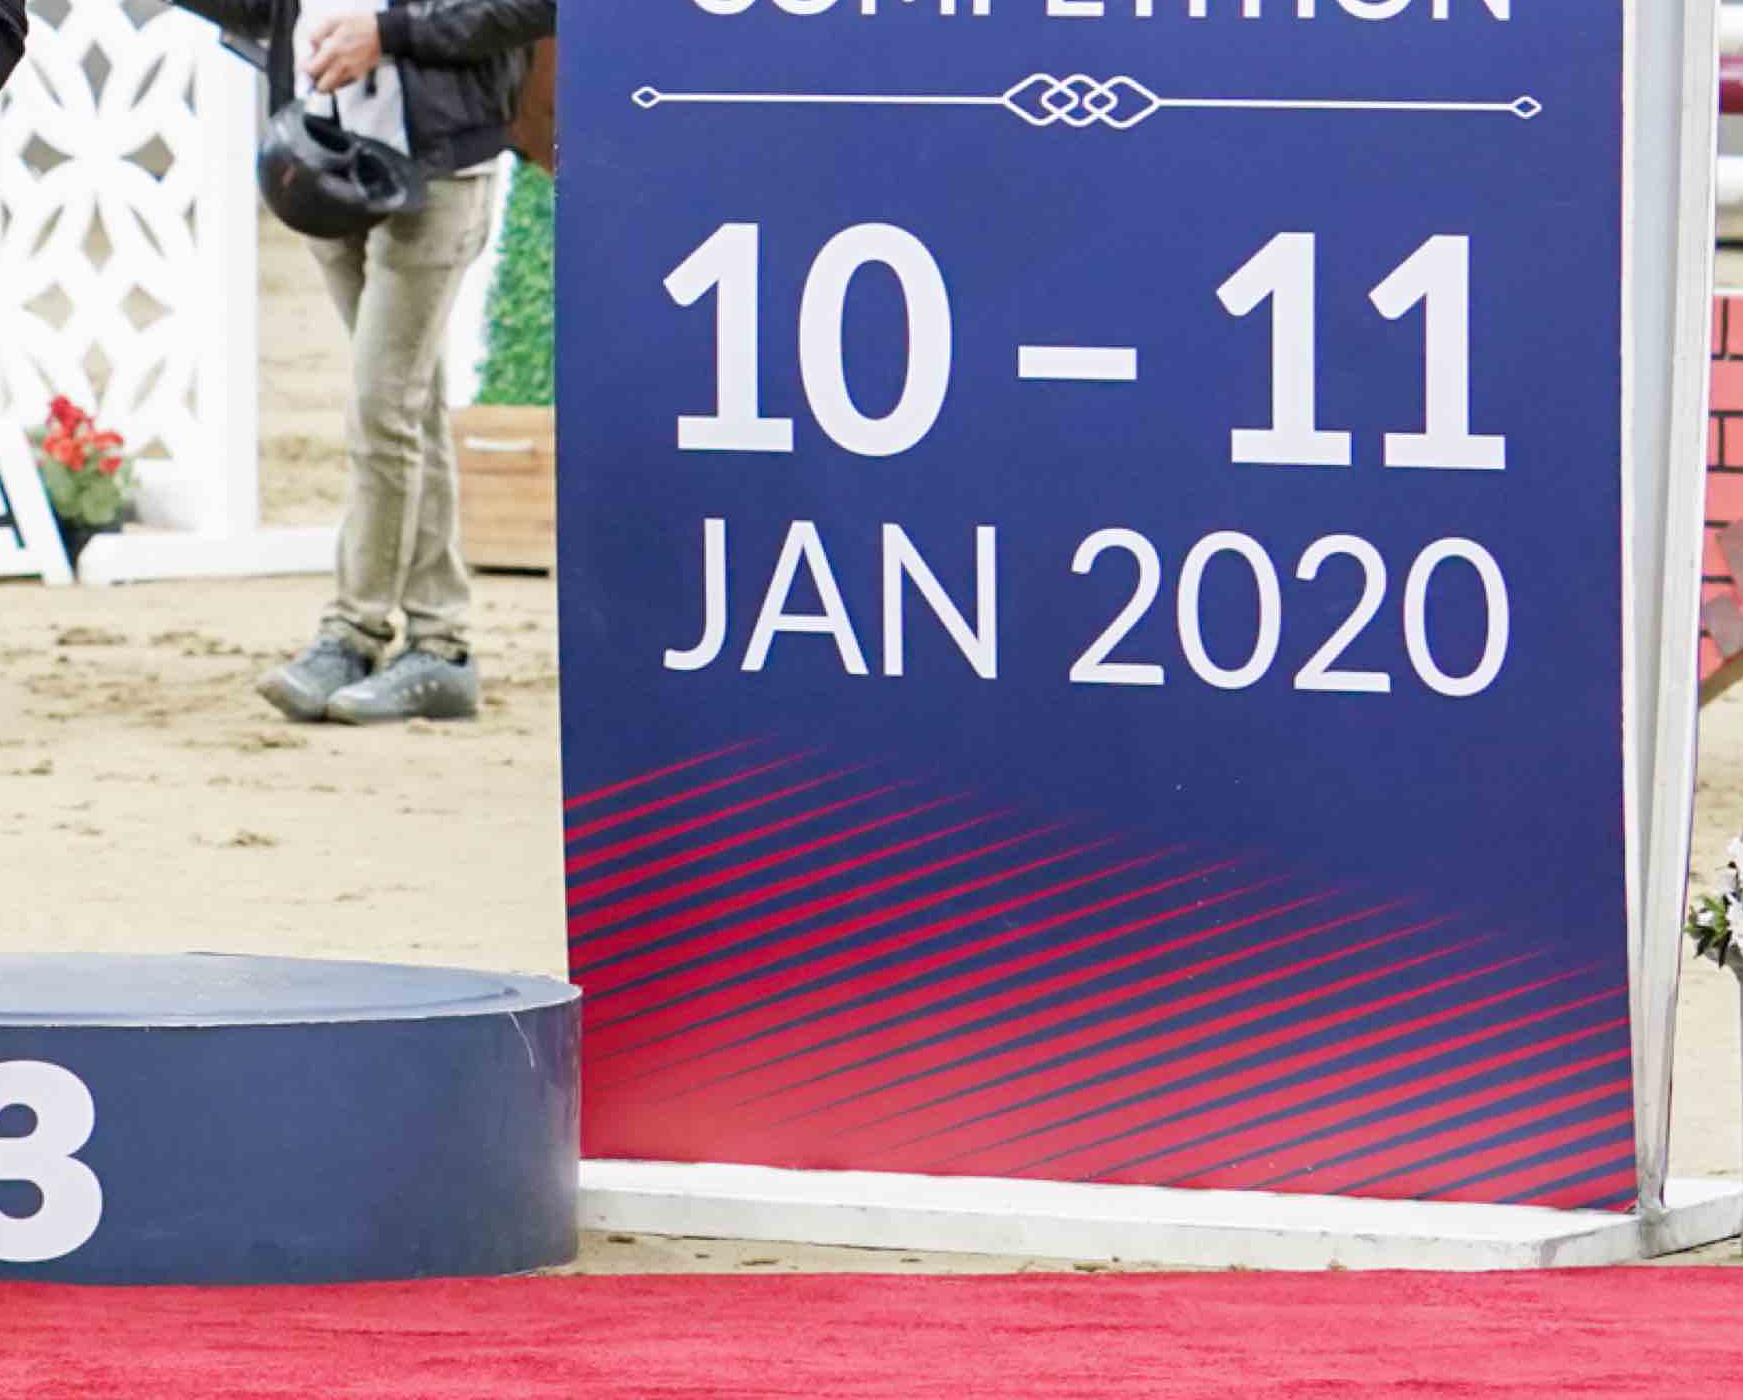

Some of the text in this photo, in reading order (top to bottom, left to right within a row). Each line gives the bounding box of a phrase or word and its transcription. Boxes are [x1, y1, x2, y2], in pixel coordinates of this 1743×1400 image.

[662, 221, 953, 457] 10
[1215, 230, 1507, 471] 11
[662, 518, 1511, 698] JAN 2020
